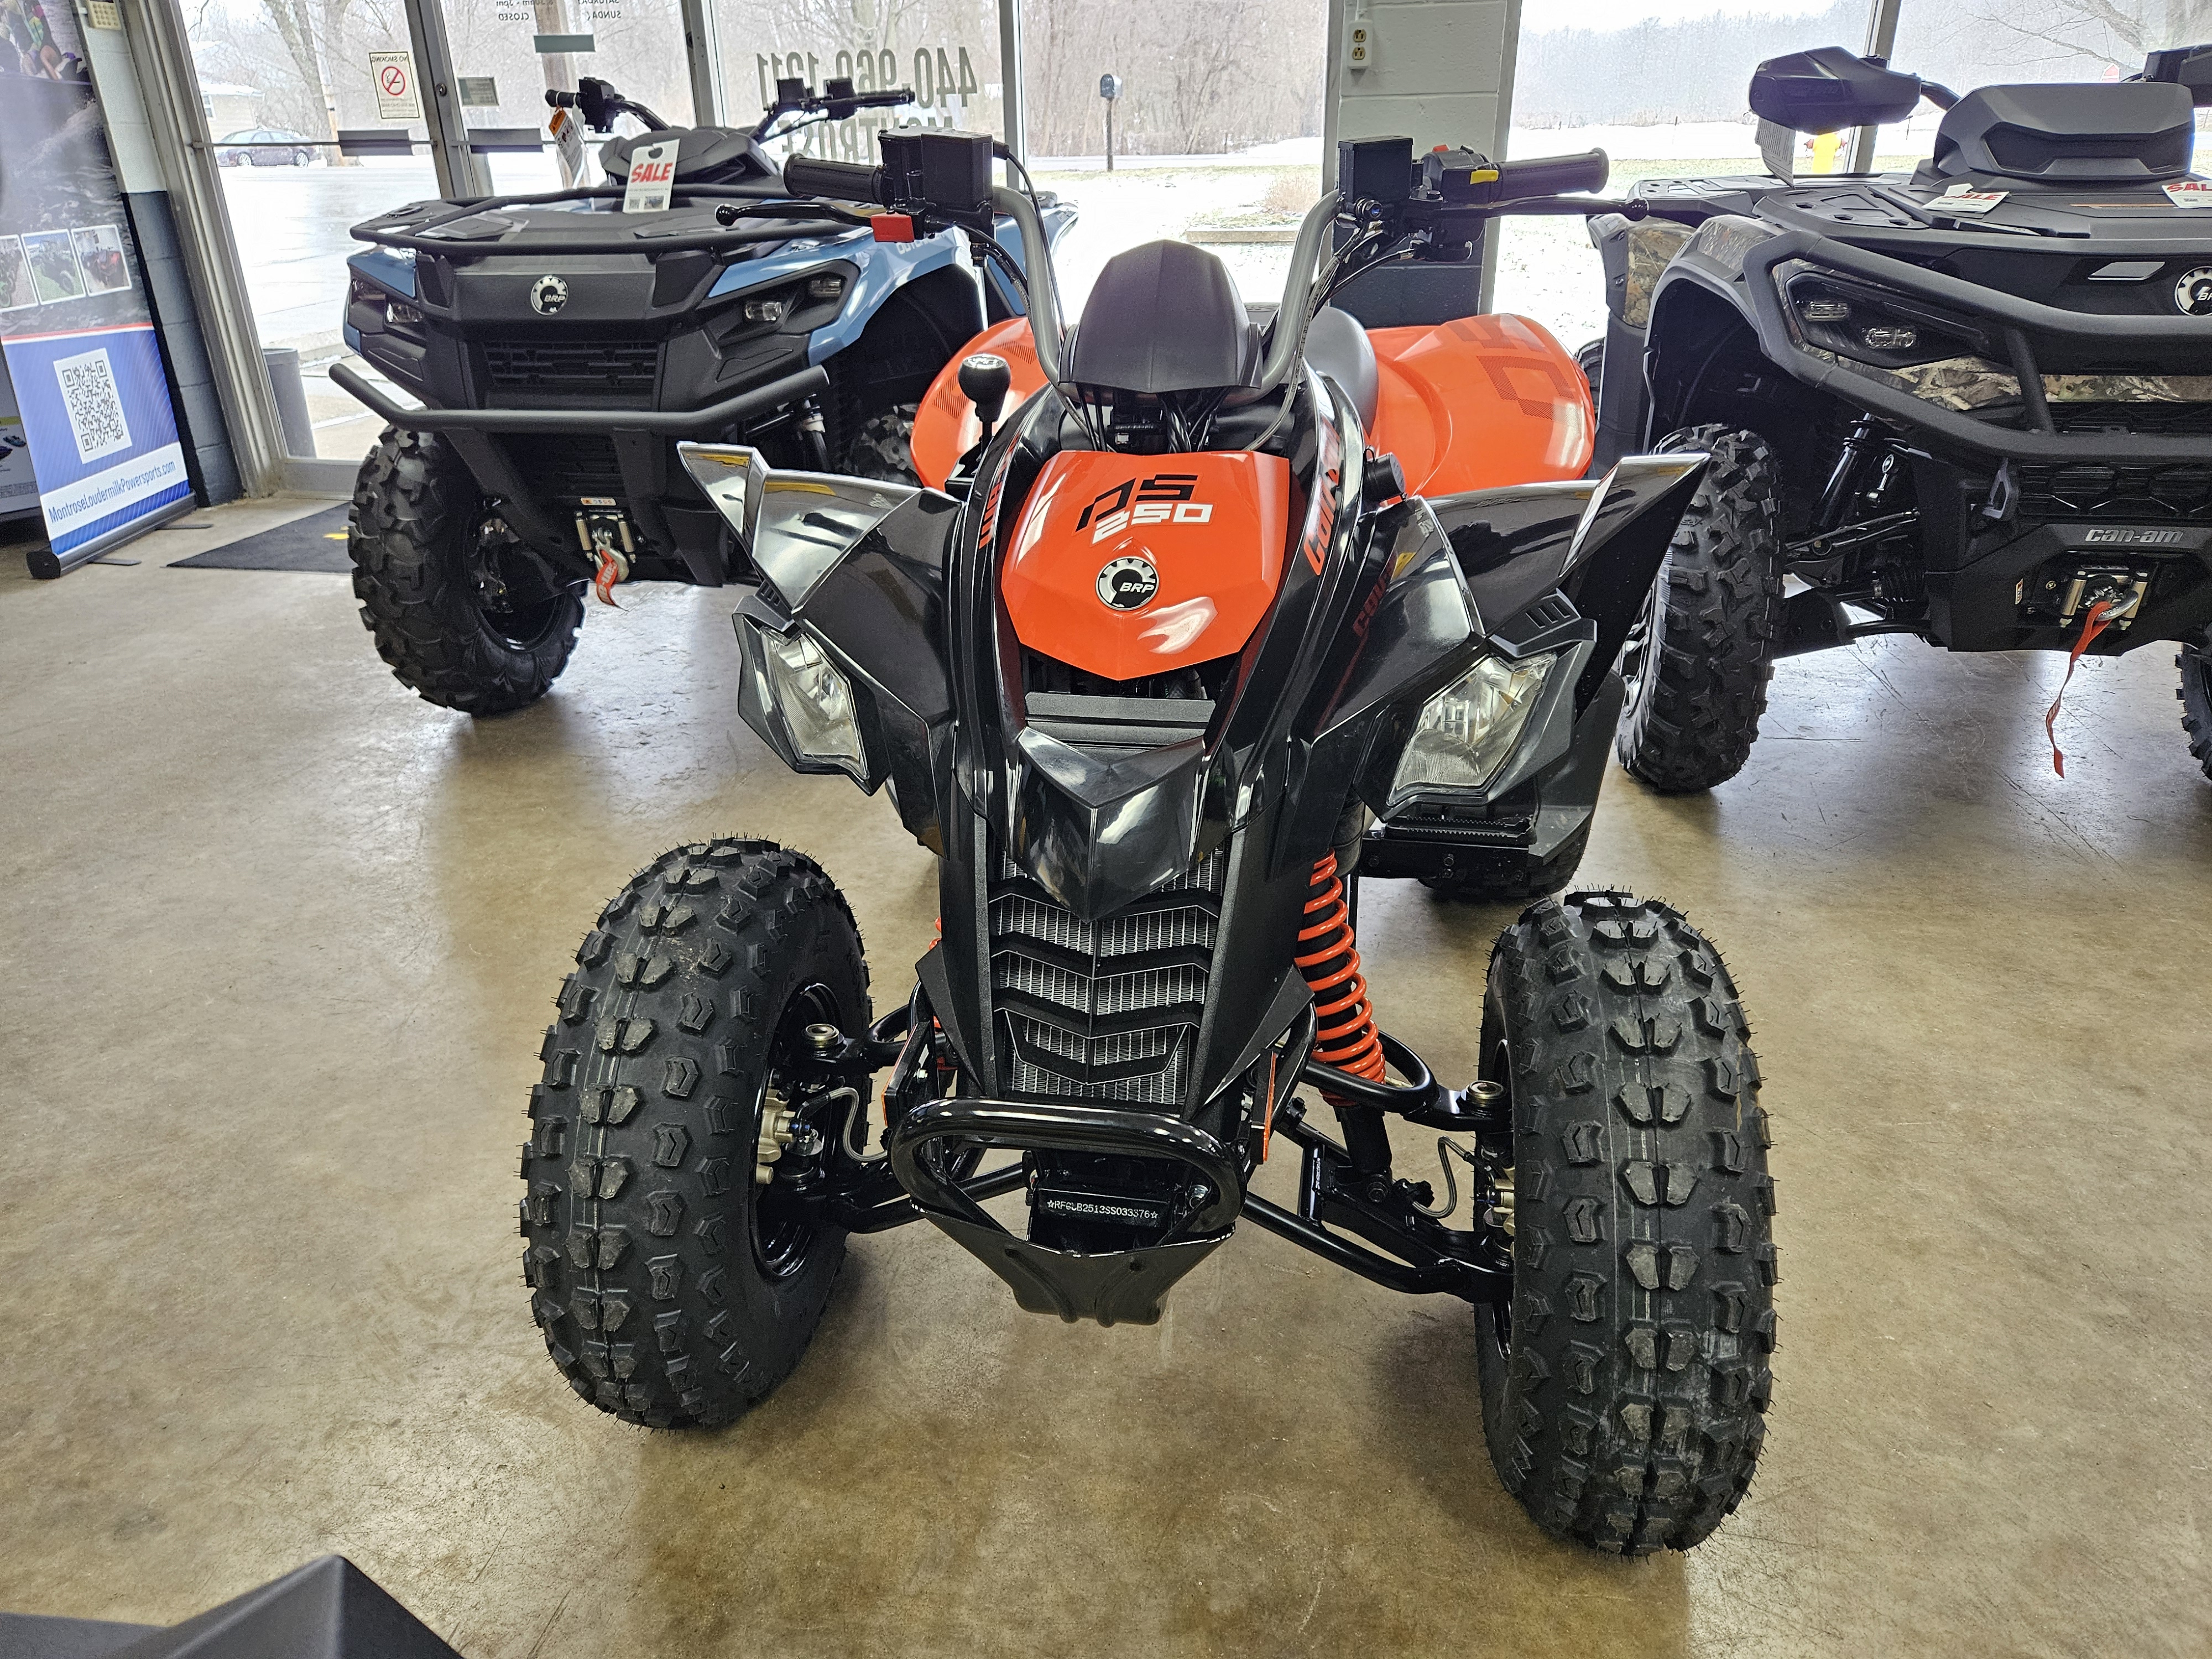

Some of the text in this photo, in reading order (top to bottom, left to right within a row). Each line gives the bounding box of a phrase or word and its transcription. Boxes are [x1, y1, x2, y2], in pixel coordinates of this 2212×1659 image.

[630, 161, 674, 183] SALE
[544, 294, 566, 302] BRP
[49, 461, 176, 523] MontroseLoudermilkPowersports.com
[1092, 503, 1213, 539] 250
[2085, 529, 2184, 544] can-am
[1119, 582, 1155, 593] BRP
